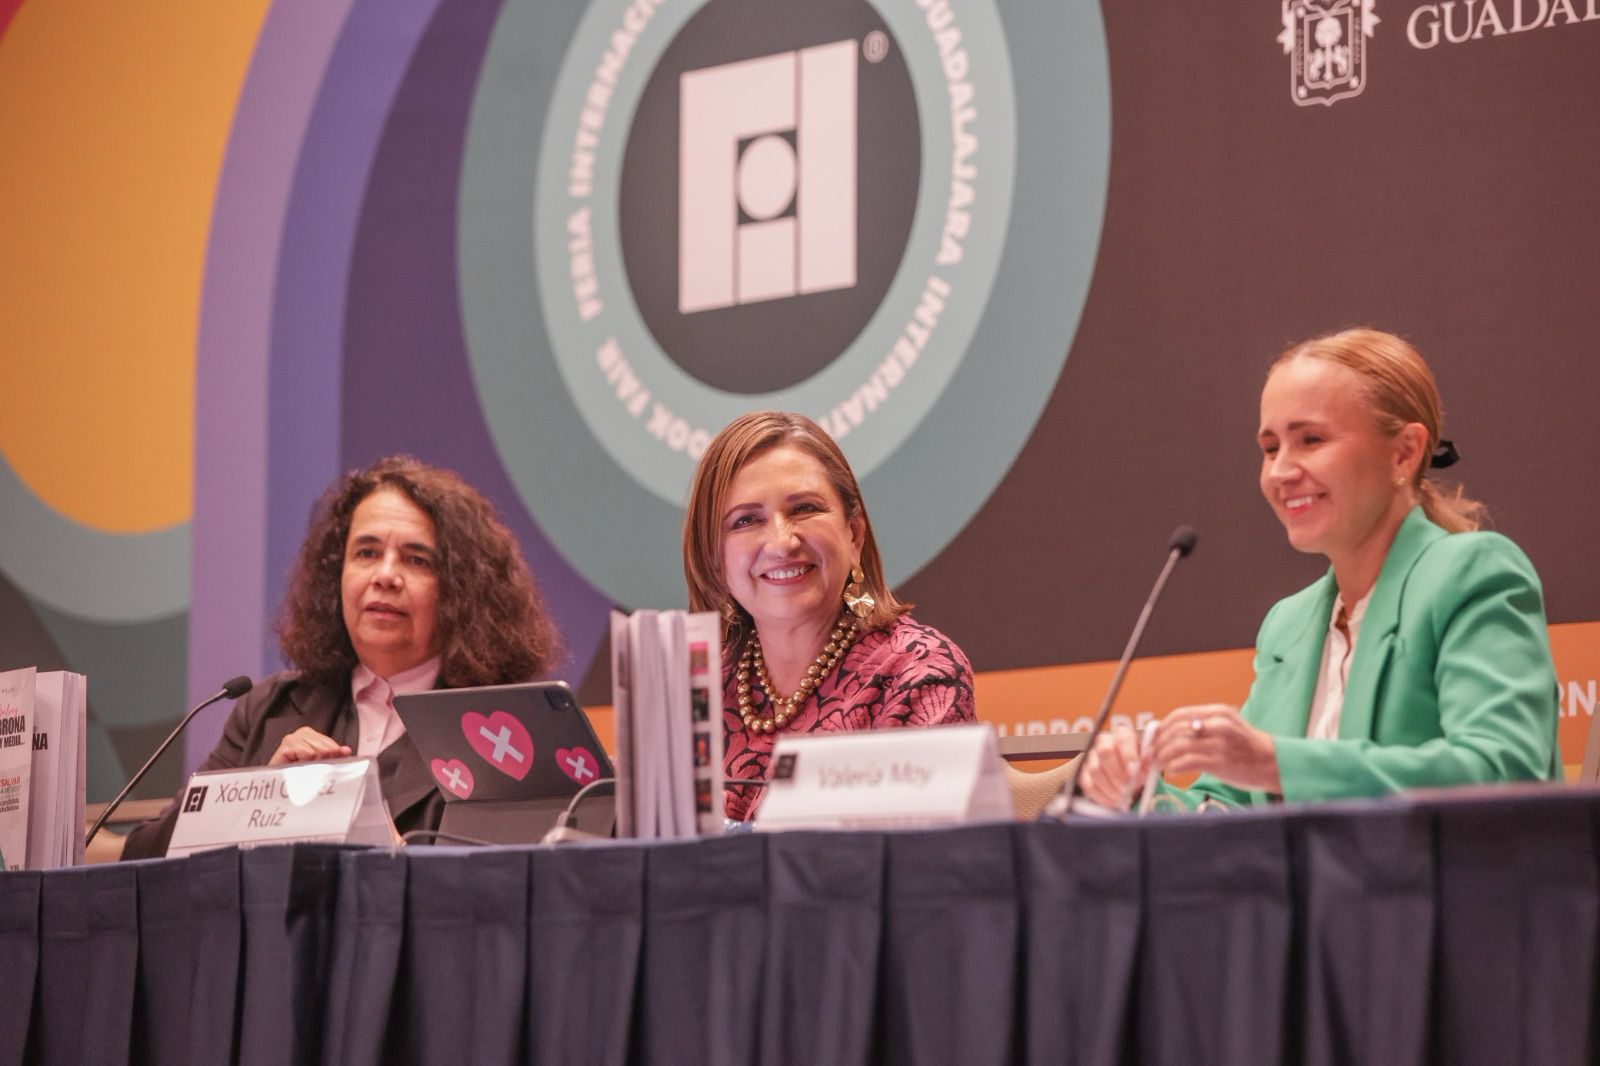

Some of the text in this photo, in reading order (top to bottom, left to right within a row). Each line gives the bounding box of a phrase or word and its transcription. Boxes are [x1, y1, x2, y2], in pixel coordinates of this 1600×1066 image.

[566, 0, 668, 322] FERIA INTERNACI
[914, 0, 977, 265] UADALAJARA
[596, 336, 713, 461] OOK FAIR
[0, 715, 25, 736] RONA
[215, 778, 276, 804] Xóchitl
